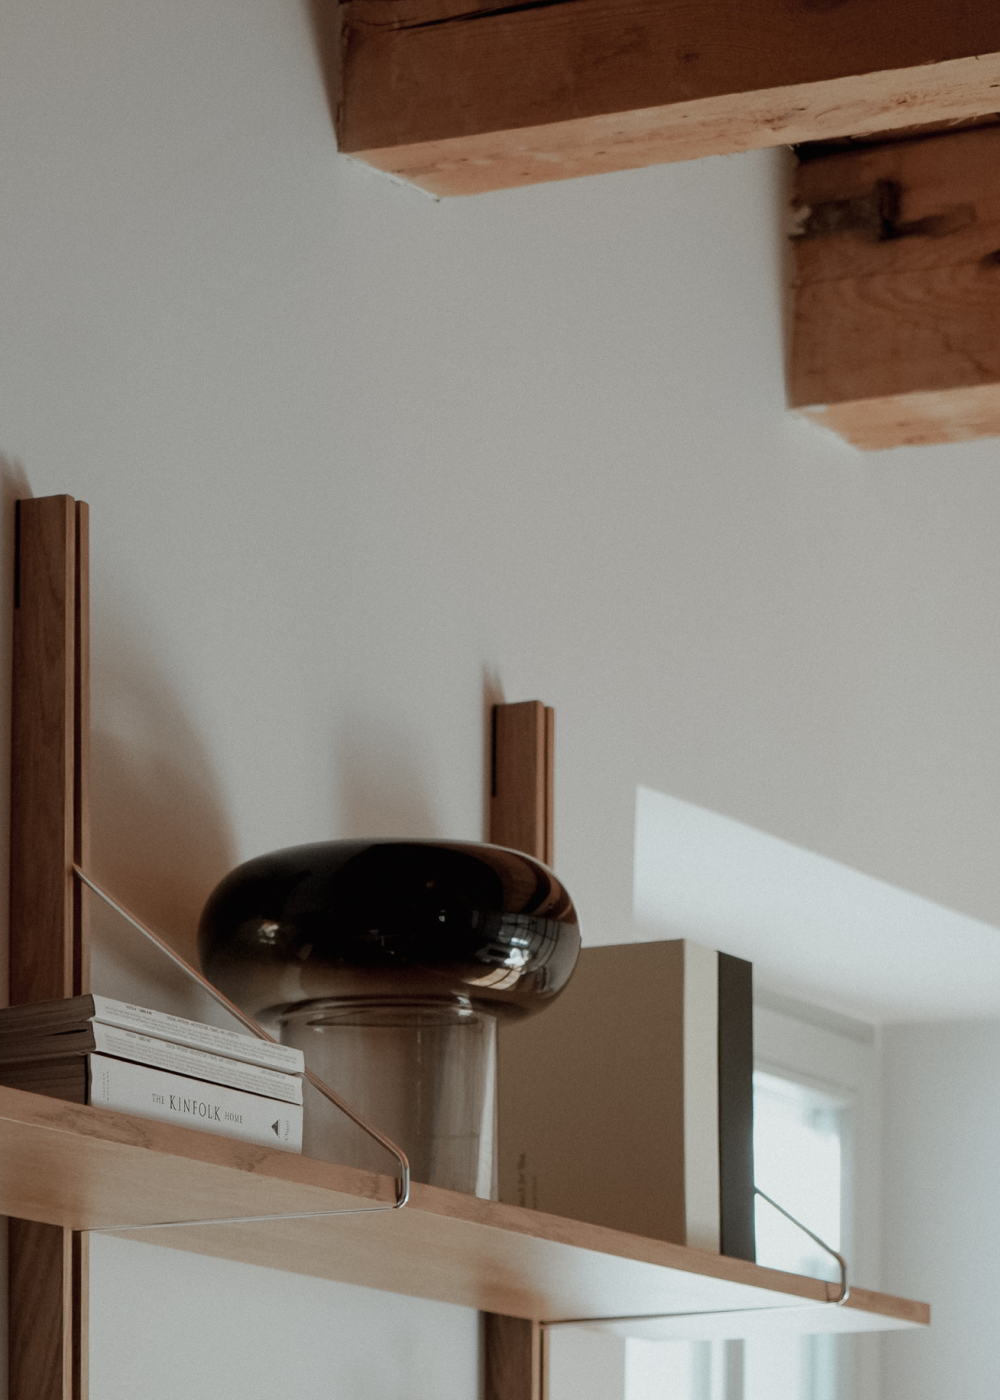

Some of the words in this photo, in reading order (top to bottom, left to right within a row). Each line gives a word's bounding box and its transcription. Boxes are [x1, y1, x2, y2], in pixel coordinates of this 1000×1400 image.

[151, 1093, 165, 1105] THE
[169, 1094, 222, 1122] KINFOLK
[224, 1111, 244, 1124] HOME
